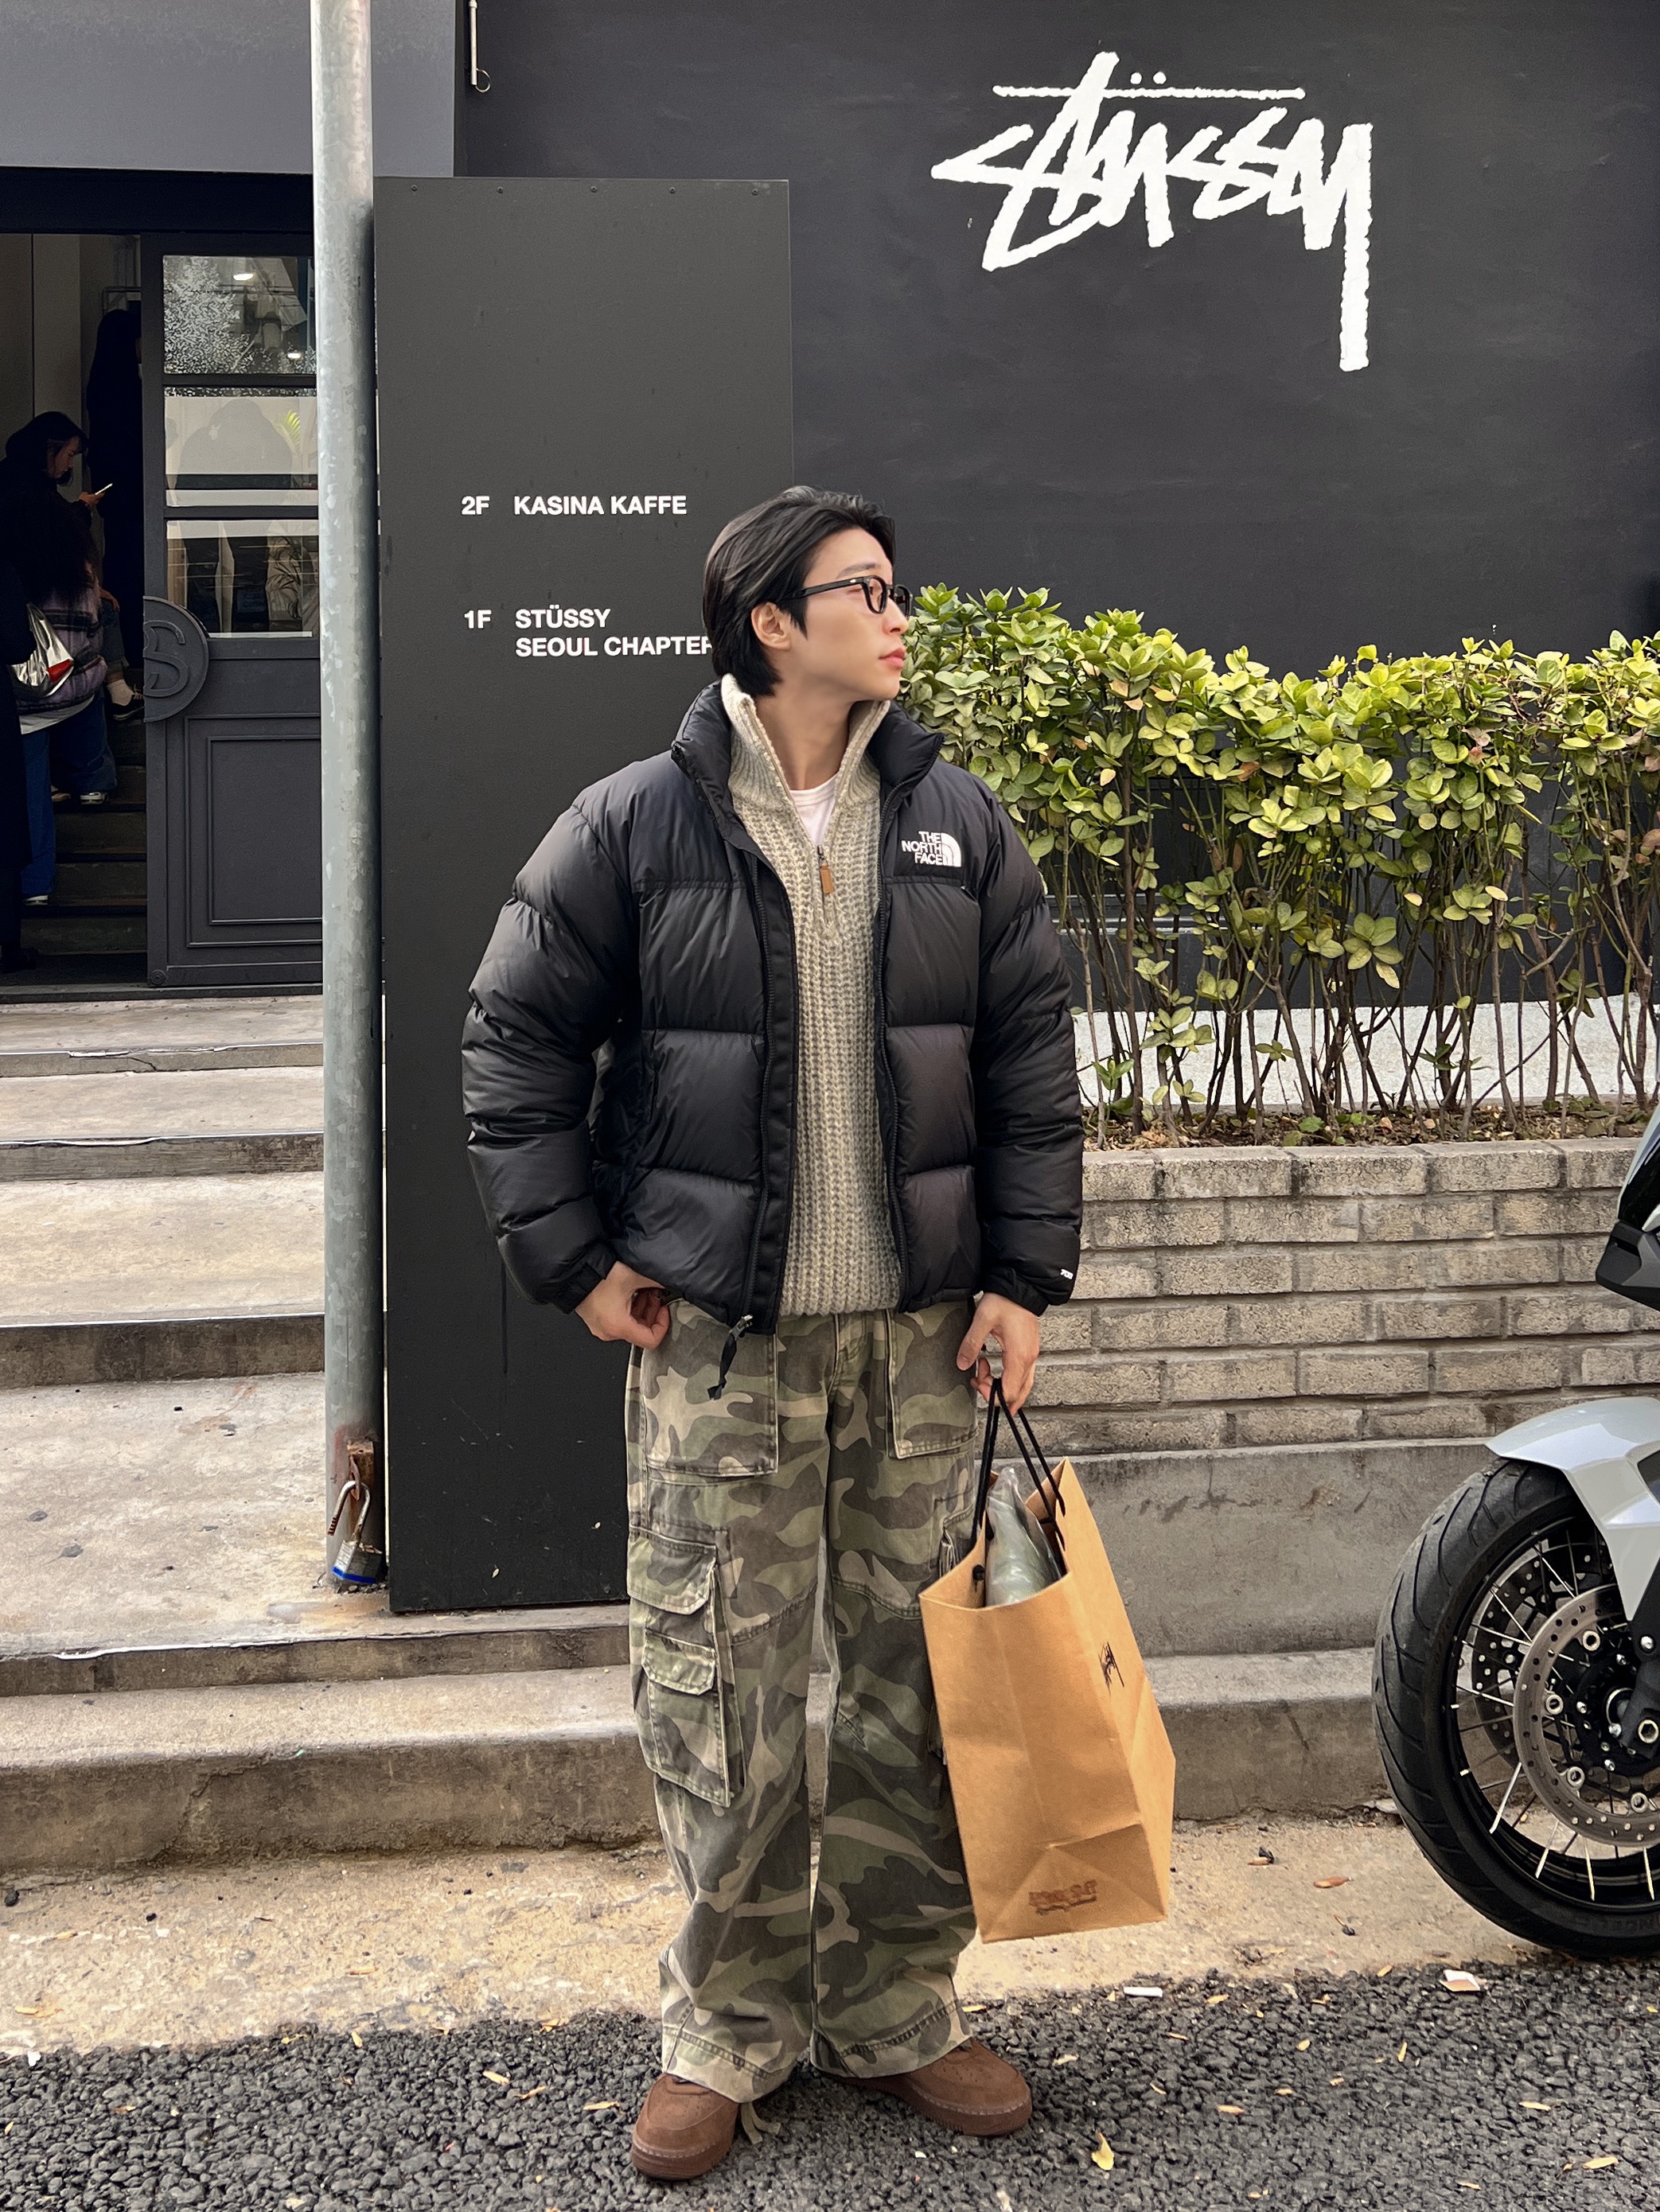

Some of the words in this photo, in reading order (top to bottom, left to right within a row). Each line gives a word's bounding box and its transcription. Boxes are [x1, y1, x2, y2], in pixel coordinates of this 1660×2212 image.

[461, 495, 490, 516] 2F
[513, 495, 605, 516] KASINA
[610, 495, 688, 515] KAFFE
[464, 609, 492, 629] 1F
[515, 604, 611, 629] STÜSSY
[515, 637, 598, 657] SEOUL
[918, 831, 941, 843] THE
[901, 840, 941, 855] NORTH
[914, 852, 943, 866] FACE
